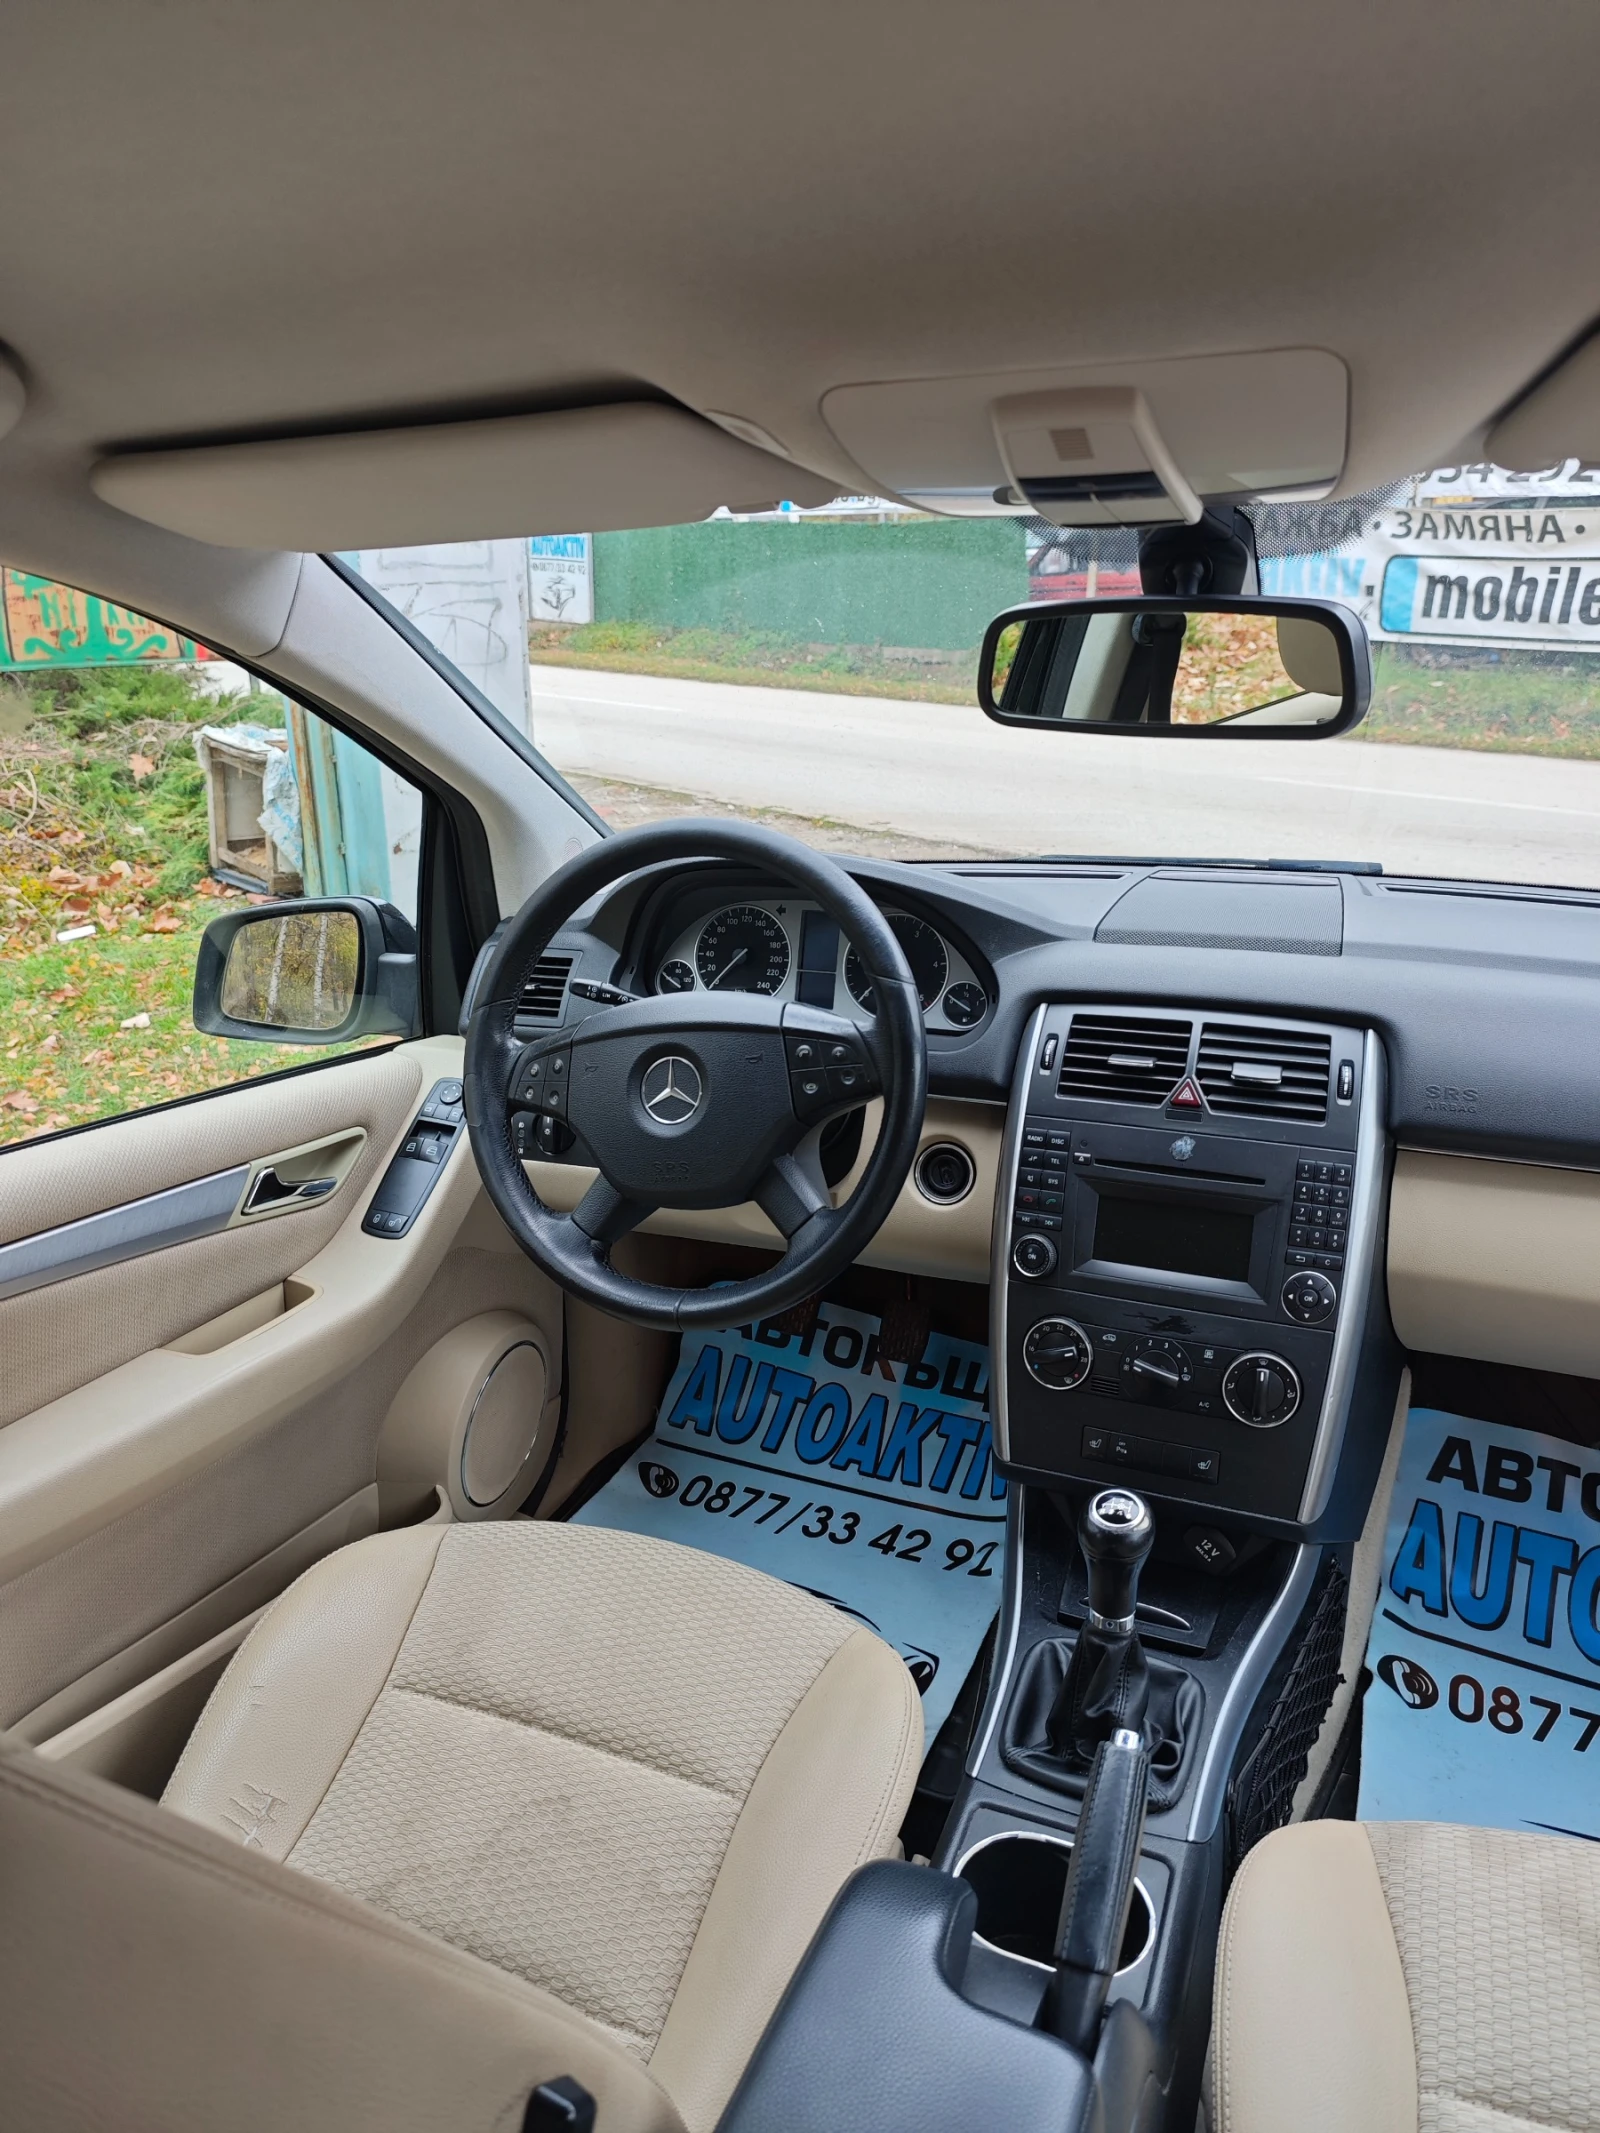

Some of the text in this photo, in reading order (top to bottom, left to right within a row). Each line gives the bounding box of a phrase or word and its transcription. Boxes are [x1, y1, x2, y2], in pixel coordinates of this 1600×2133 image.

[1390, 510, 1566, 543] ЗАМЯНА
[1425, 1085, 1479, 1101] SRS
[1027, 1134, 1044, 1142] RADIO
[1051, 1157, 1060, 1165] TEL
[678, 1474, 861, 1545] 0877/33
[868, 1524, 932, 1563] 42
[1201, 1539, 1220, 1557] 12 V
